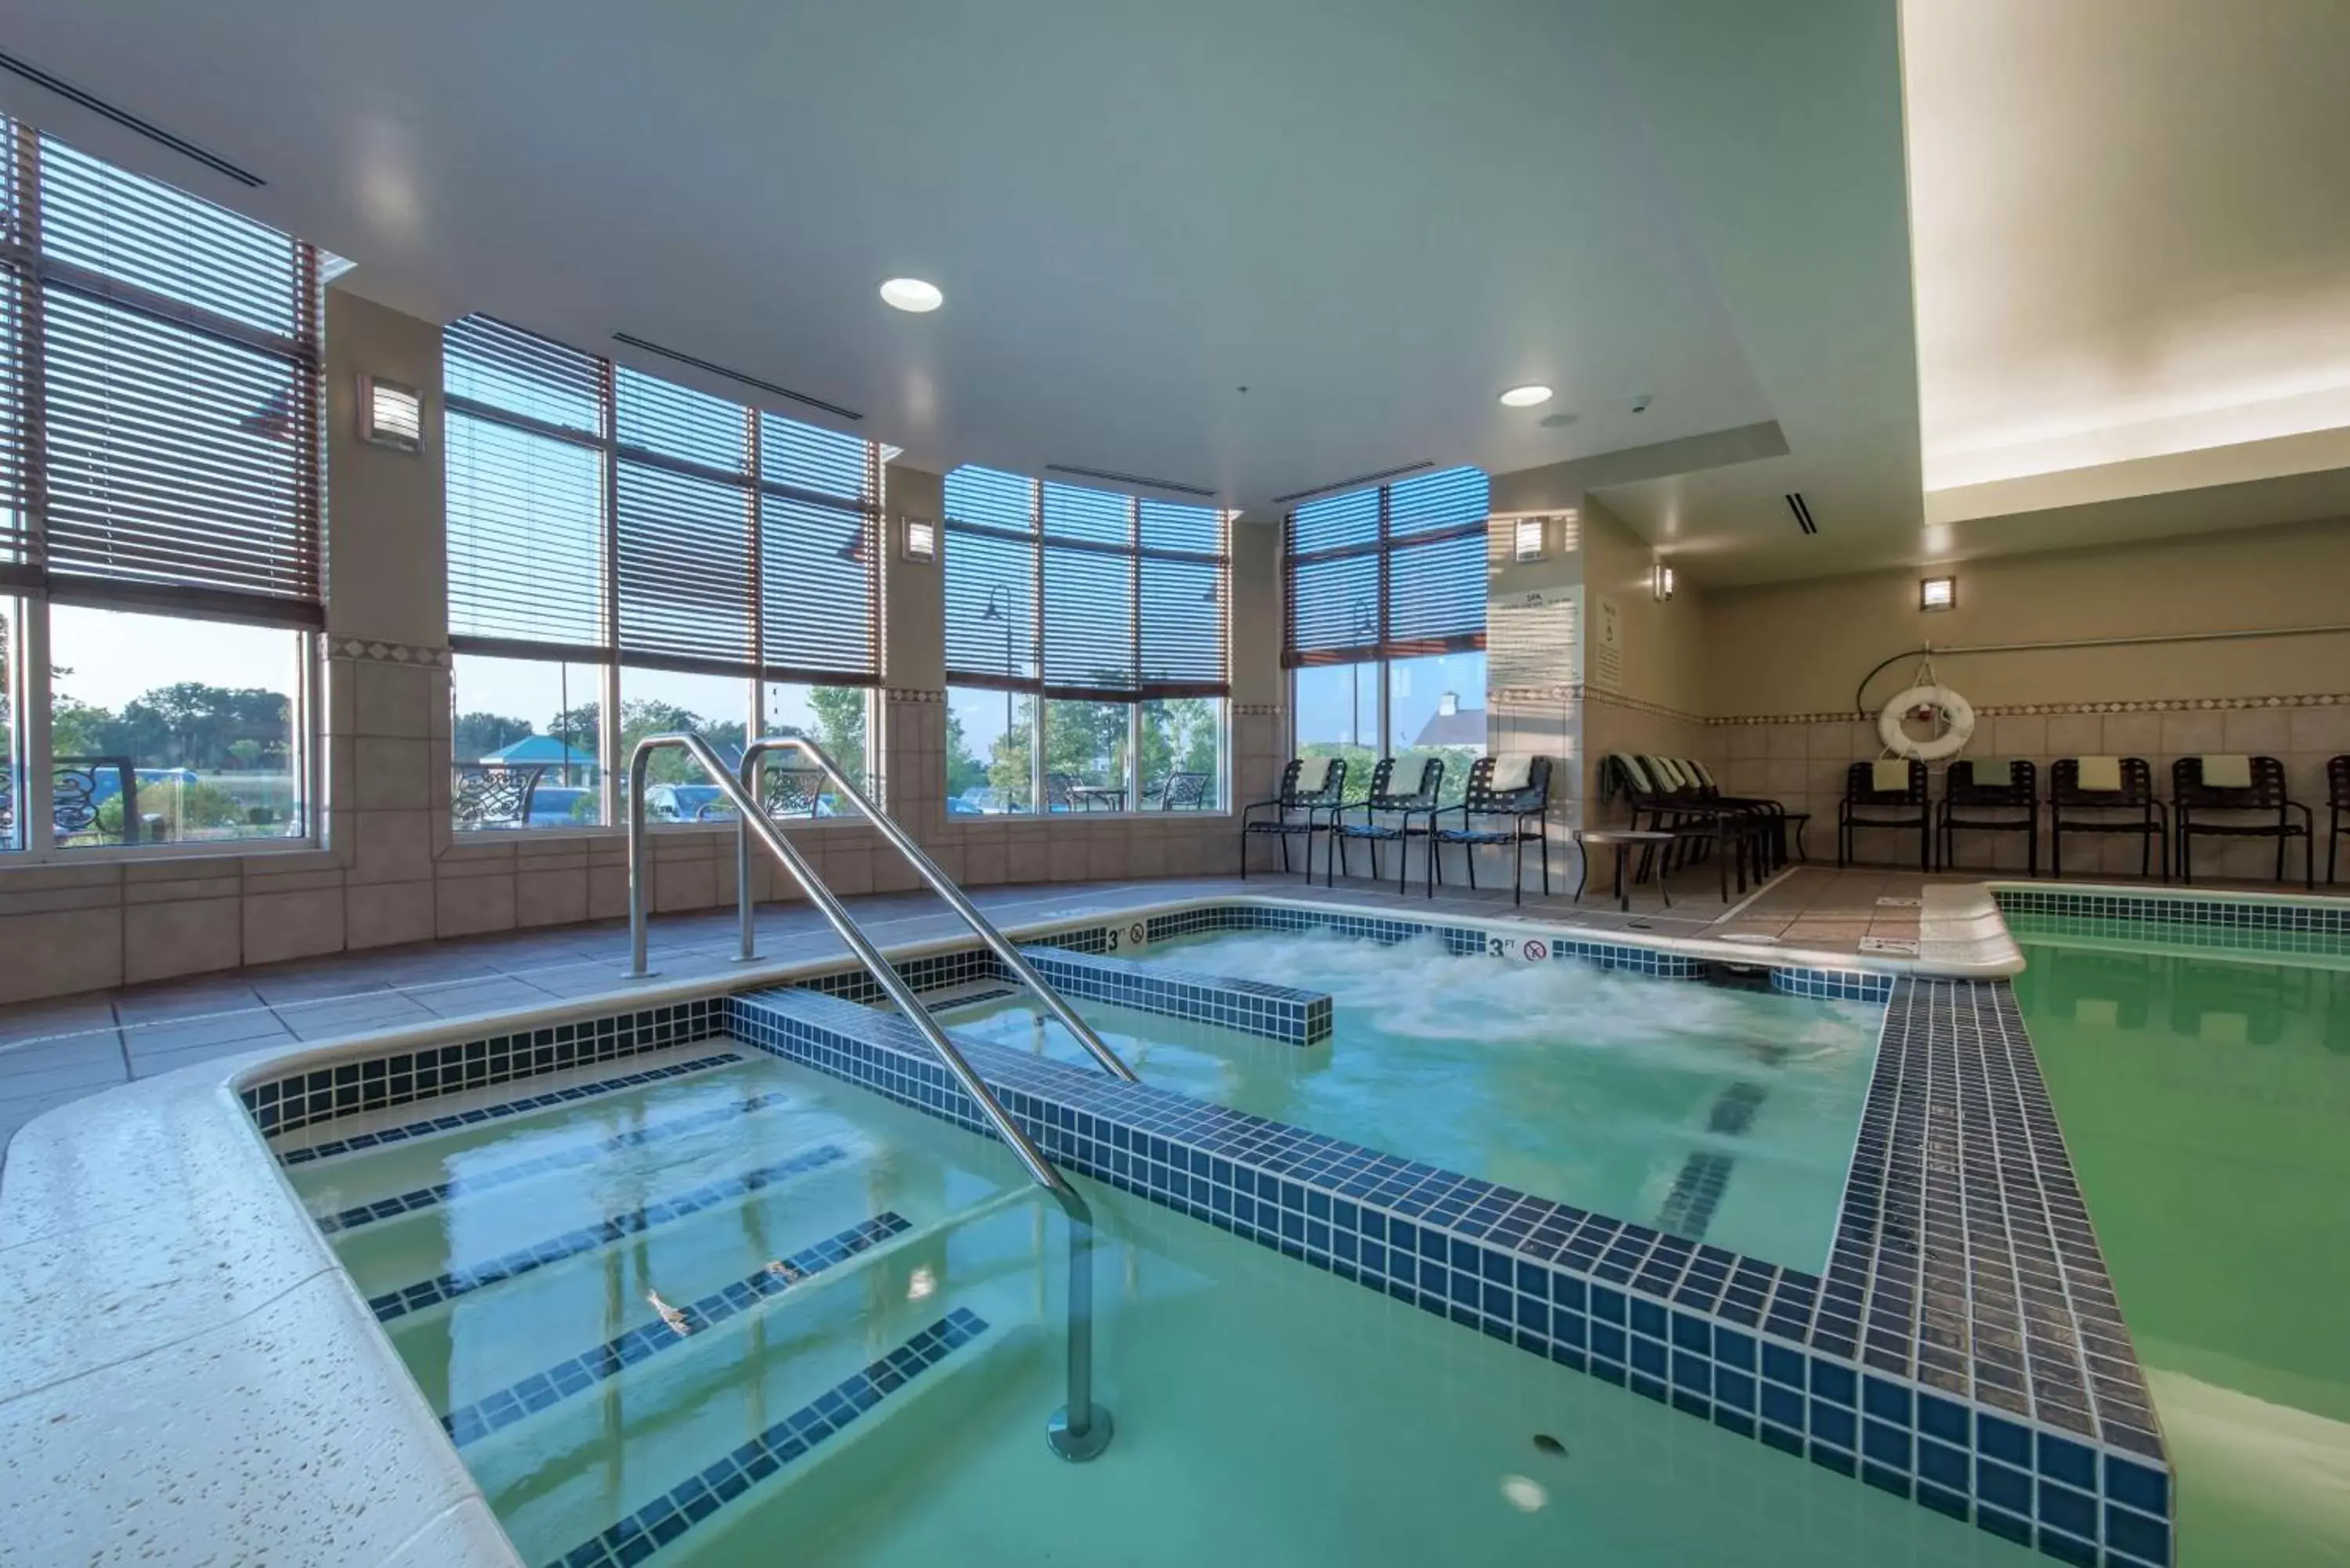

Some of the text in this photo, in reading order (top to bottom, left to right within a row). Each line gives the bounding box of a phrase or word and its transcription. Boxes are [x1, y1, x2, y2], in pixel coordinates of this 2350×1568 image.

[1108, 930, 1118, 950] 3
[1489, 938, 1515, 957] 3 FT
